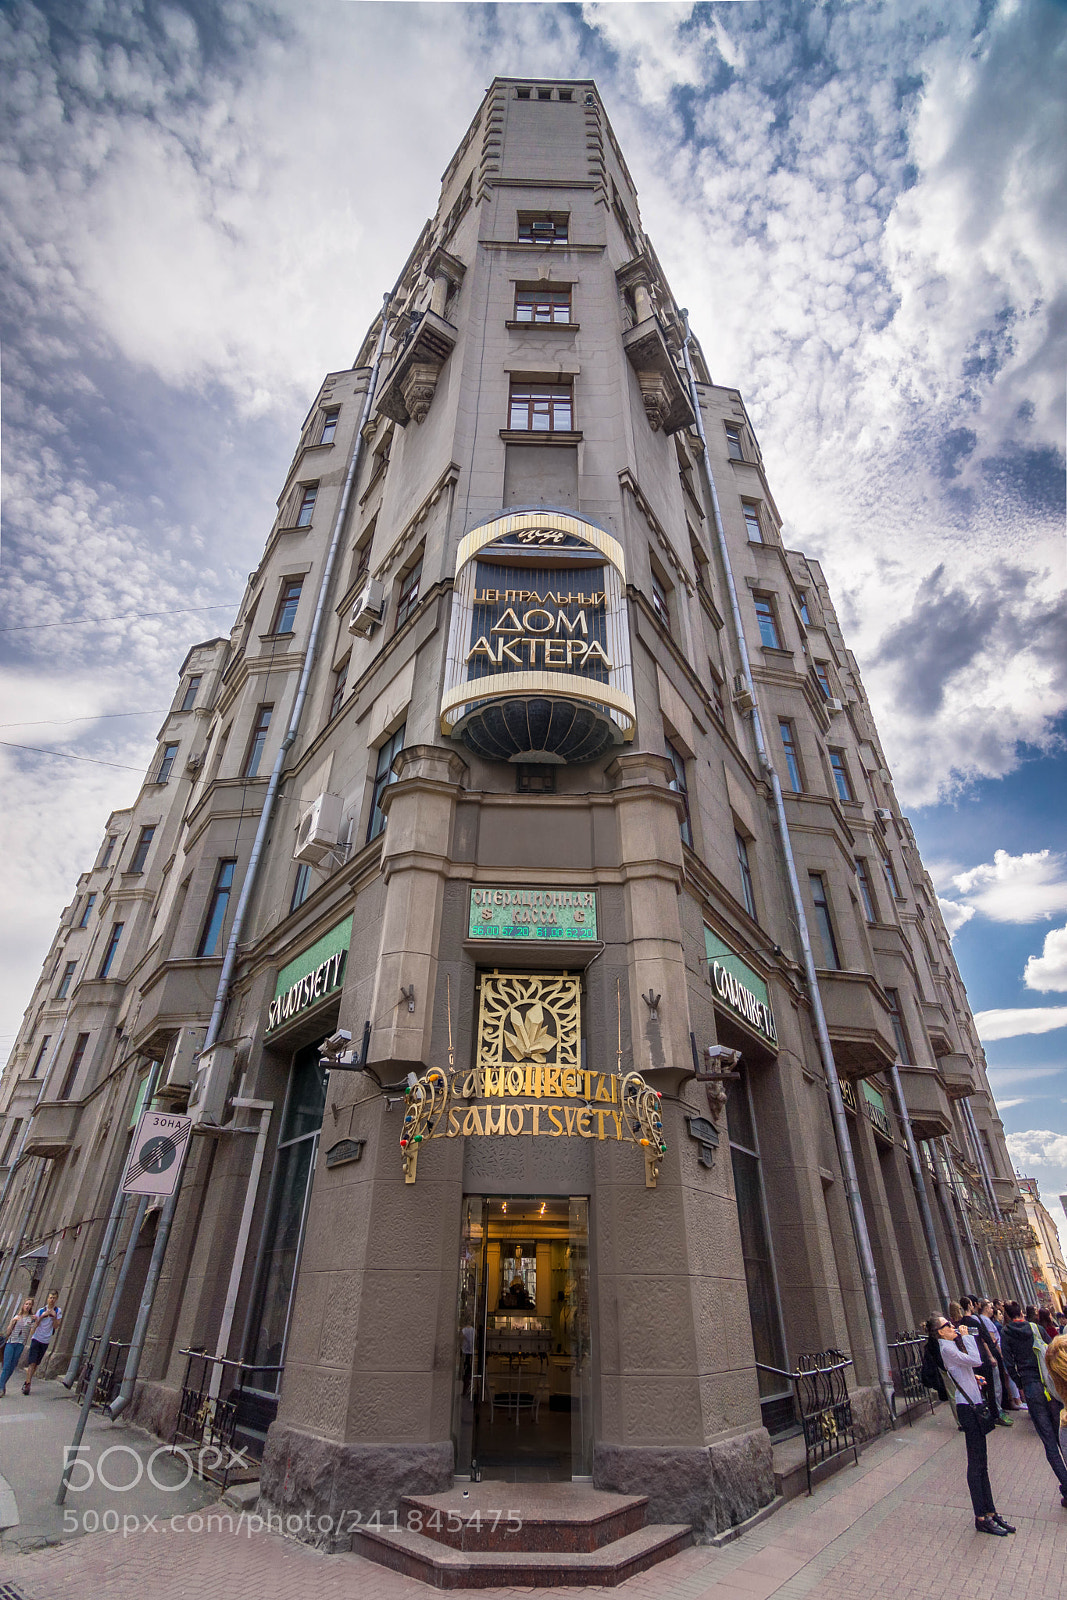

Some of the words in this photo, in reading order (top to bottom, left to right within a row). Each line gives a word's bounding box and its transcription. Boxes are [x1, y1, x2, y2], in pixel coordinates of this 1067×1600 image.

[473, 588, 608, 607] ЦЕНТРАЛЬНЫЙ
[490, 607, 588, 637] ДОМ
[465, 636, 613, 669] АКТЕРА
[474, 890, 593, 908] ОПЕРАЦИОННАЯ
[512, 909, 557, 924] КАССА
[566, 927, 593, 938] 62,20
[452, 1066, 618, 1104] САМОЦВЕТЫ
[153, 1118, 181, 1129] ЗОНА
[448, 1104, 623, 1141] SAMOTSVETY
